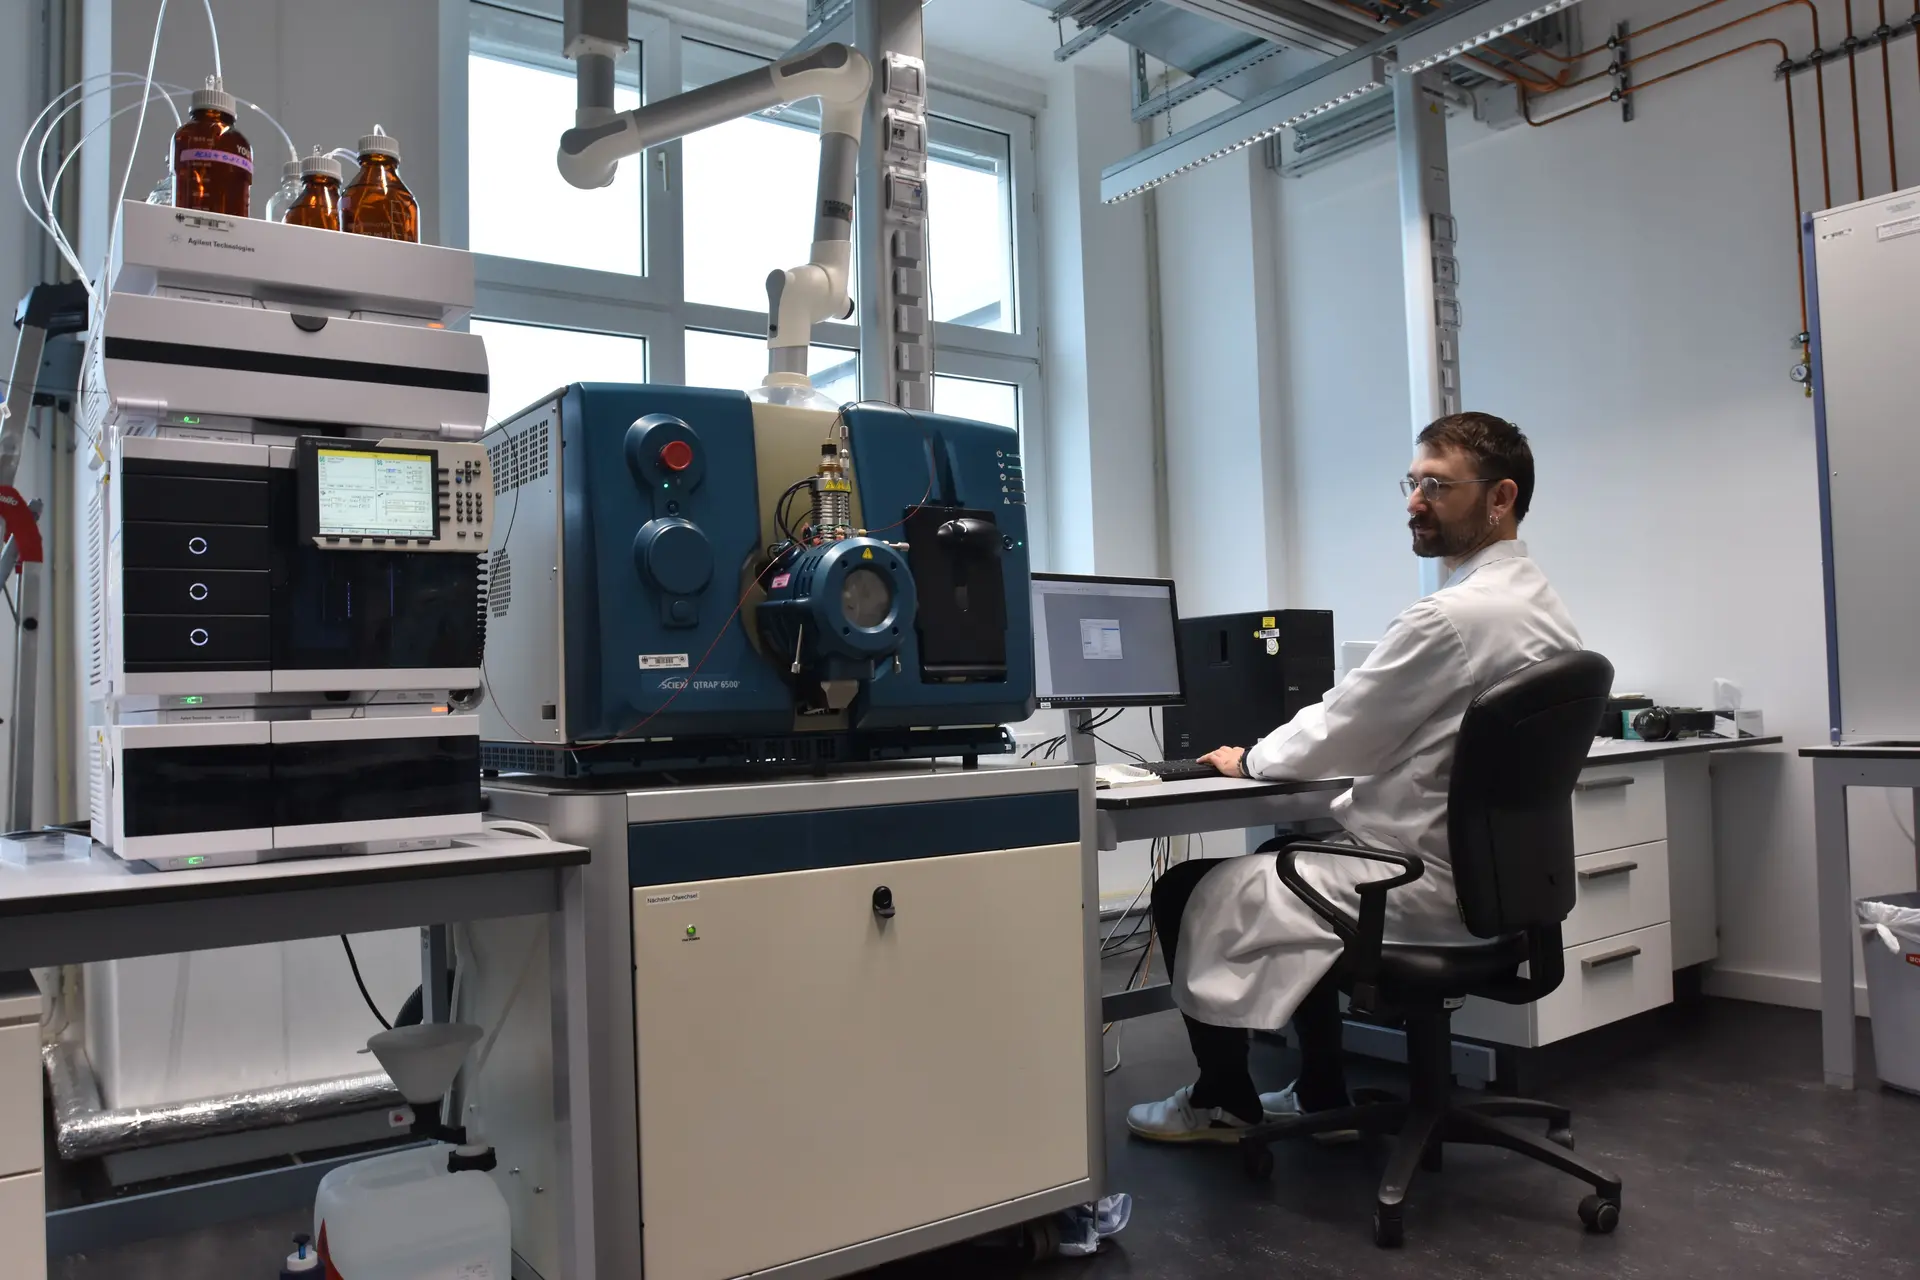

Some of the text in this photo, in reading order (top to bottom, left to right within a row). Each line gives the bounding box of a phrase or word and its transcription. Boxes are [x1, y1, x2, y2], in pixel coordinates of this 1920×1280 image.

[188, 237, 255, 253] Agilent Technologies
[658, 678, 689, 689] SCIEX
